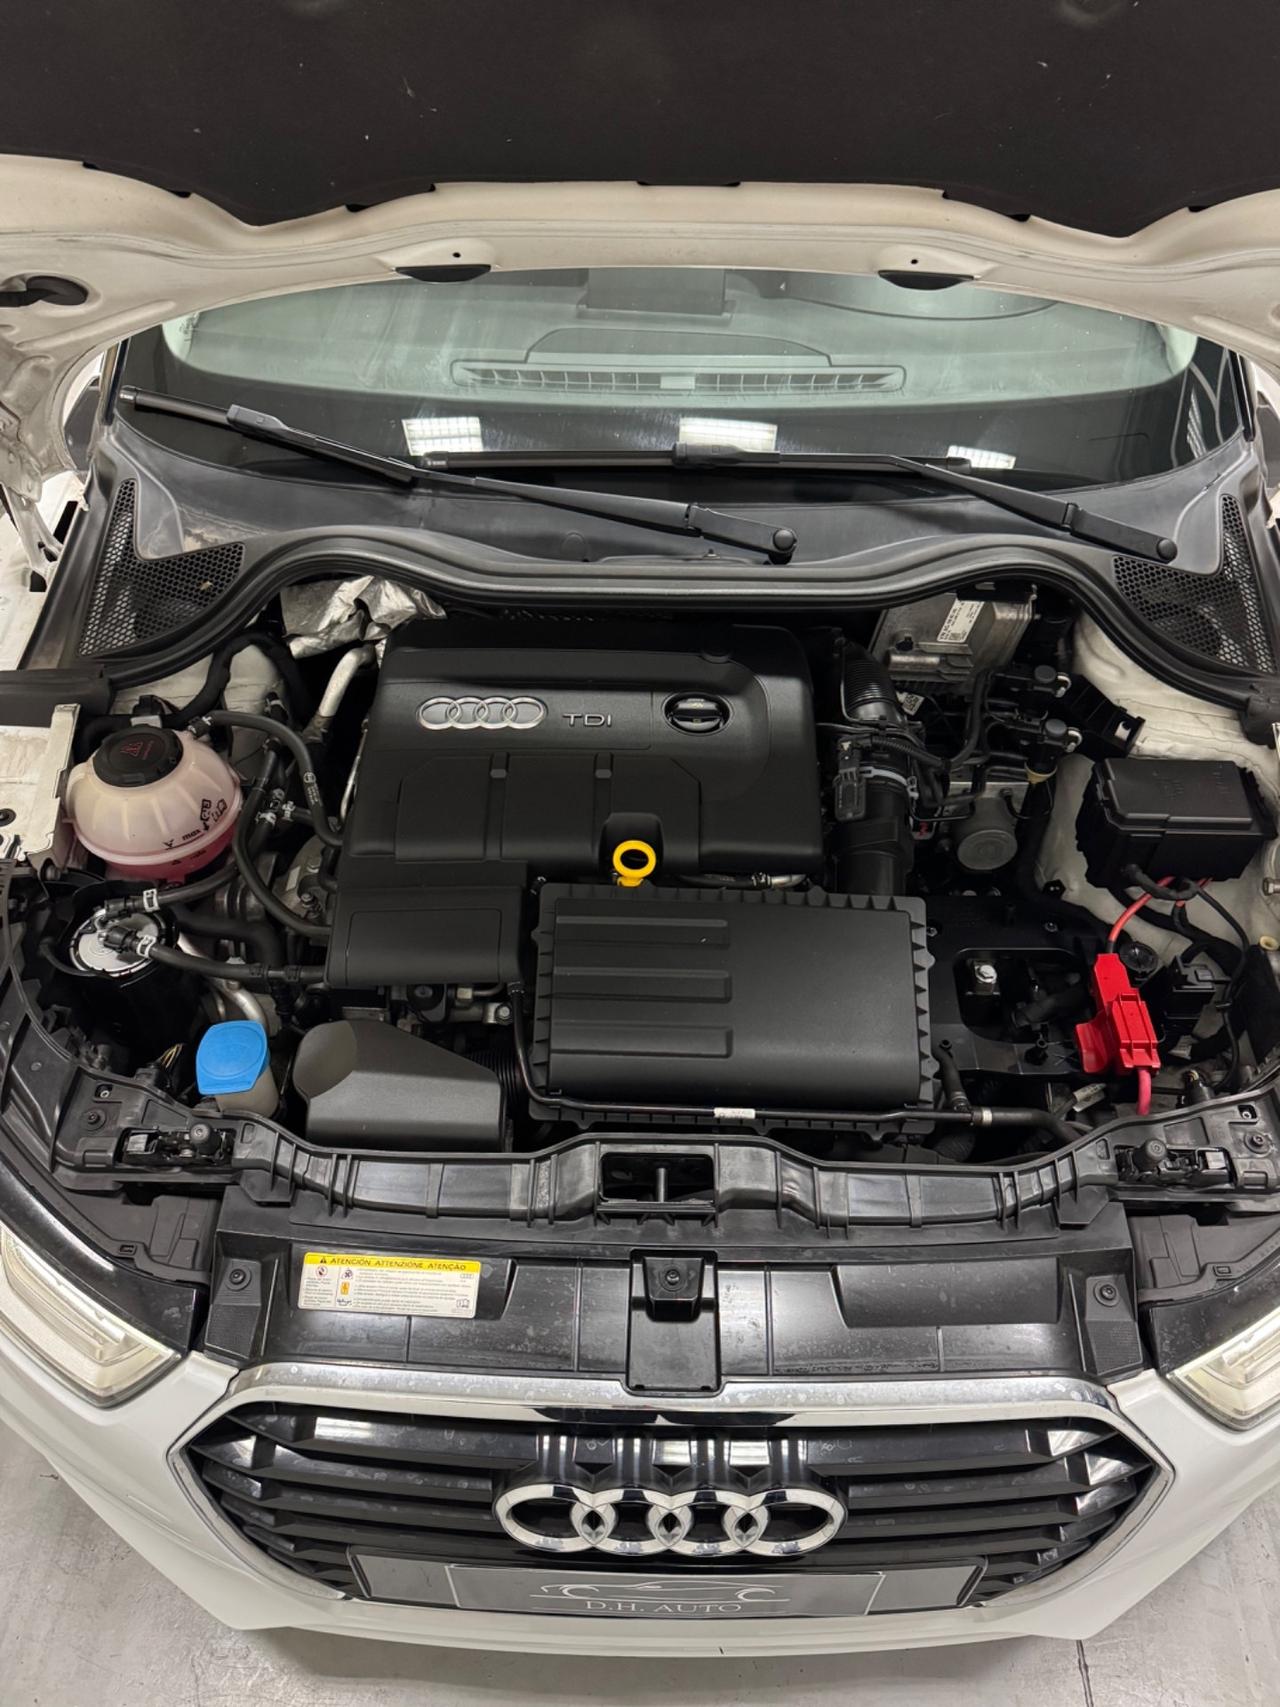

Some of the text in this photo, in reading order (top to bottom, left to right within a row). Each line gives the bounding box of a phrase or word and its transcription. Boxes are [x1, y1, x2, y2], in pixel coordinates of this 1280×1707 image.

[562, 713, 611, 726] TDI
[182, 829, 201, 840] max
[586, 1601, 741, 1613] D.H. AUTO
